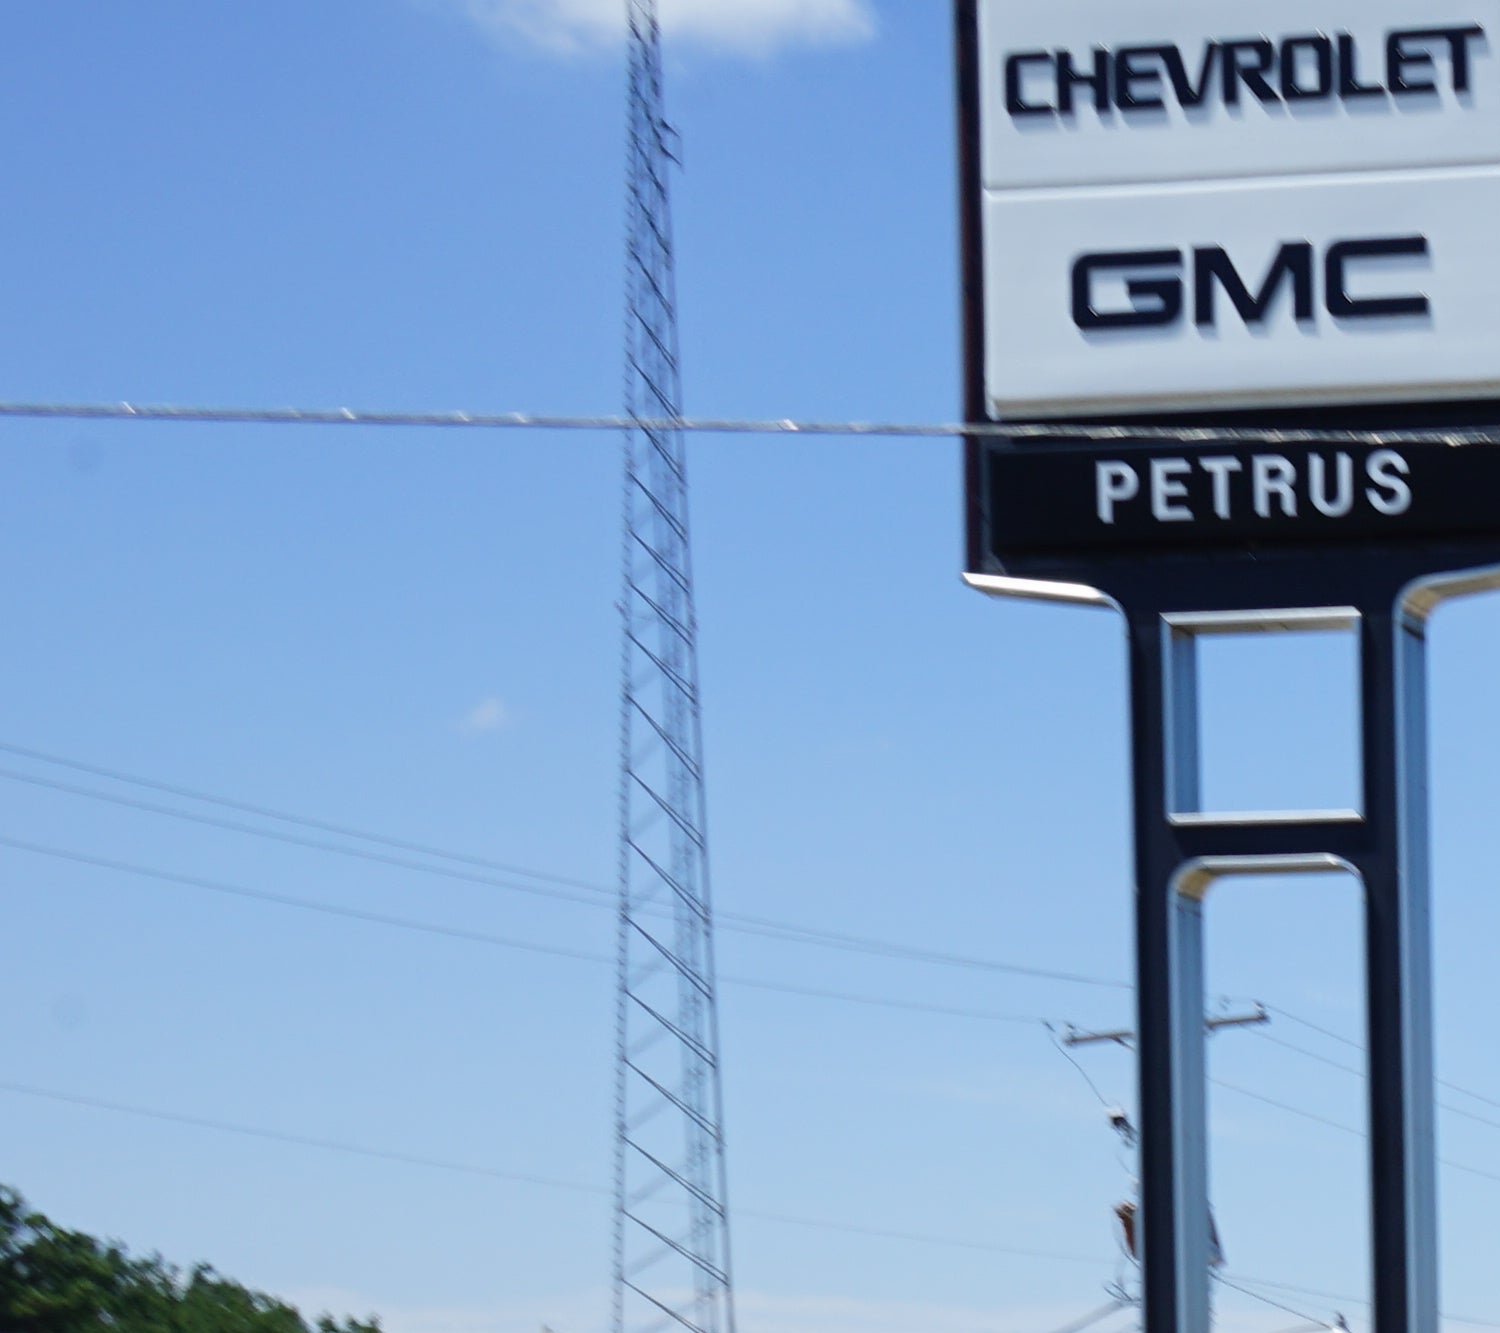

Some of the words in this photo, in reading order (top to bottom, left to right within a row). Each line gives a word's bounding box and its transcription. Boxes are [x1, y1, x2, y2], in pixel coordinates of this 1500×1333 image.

[1005, 23, 1485, 117] CHEVROLET
[1071, 235, 1429, 330] GMC
[1096, 450, 1412, 523] PETRUS
